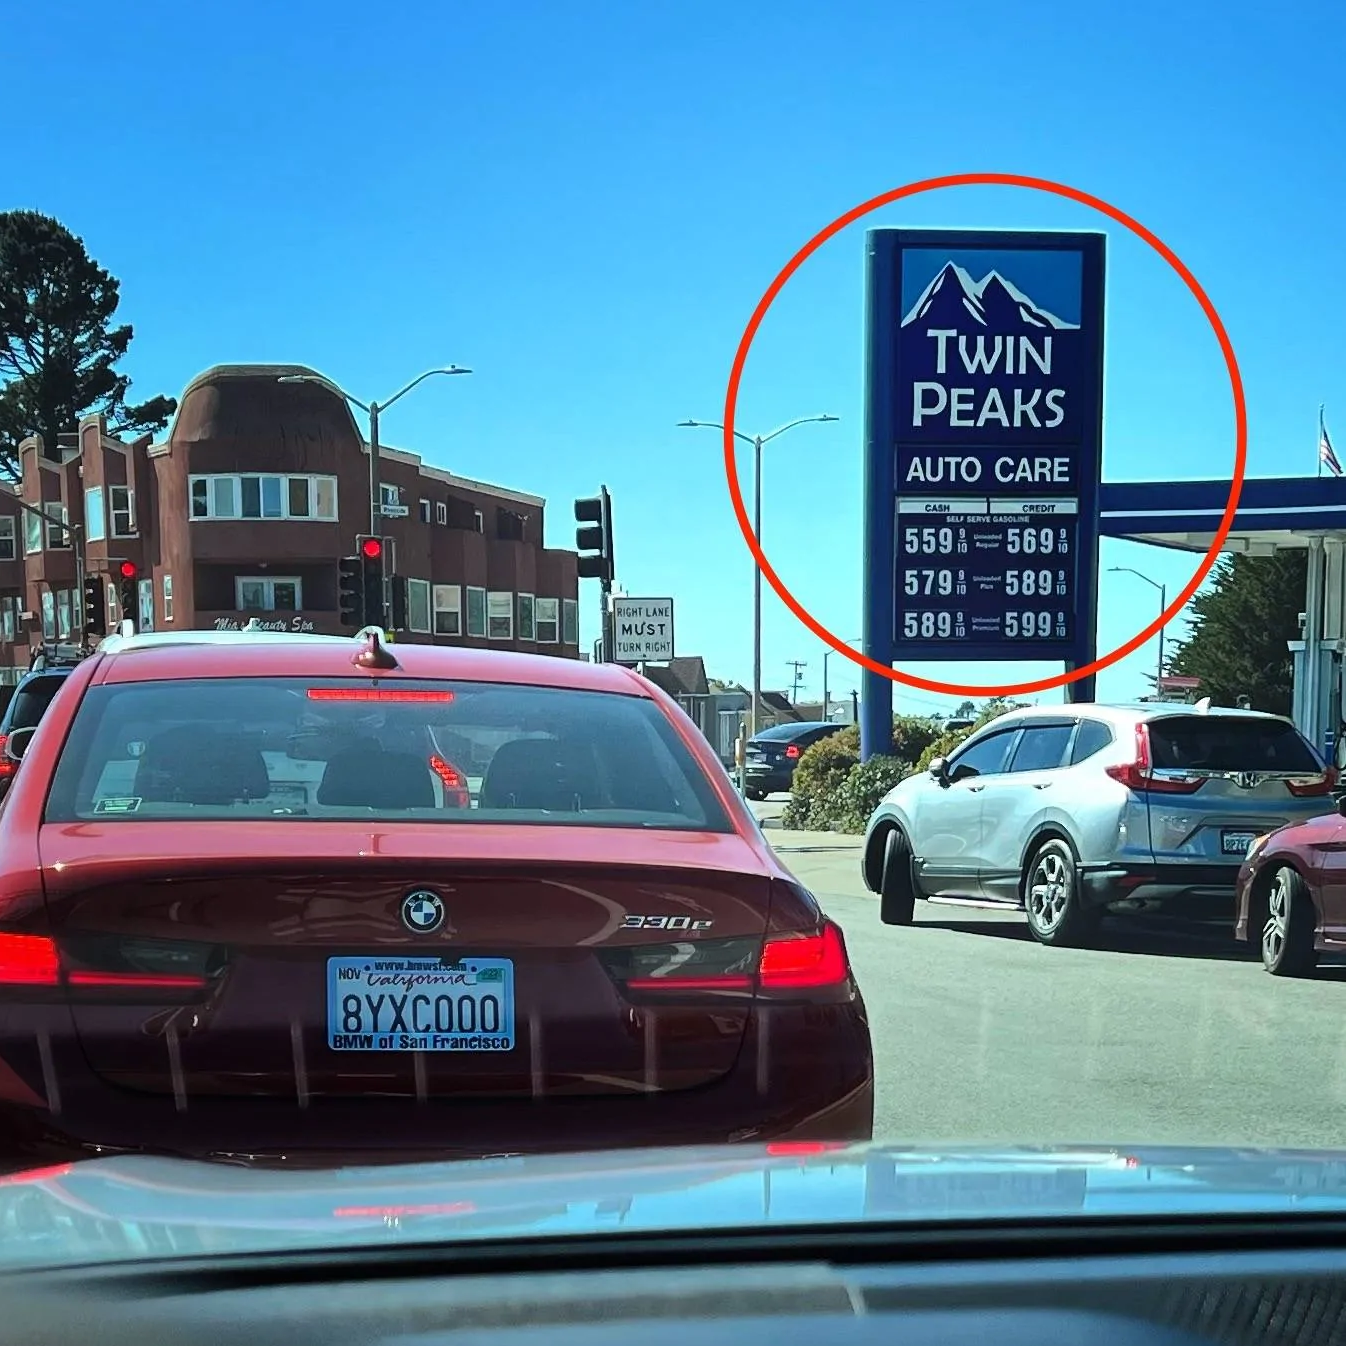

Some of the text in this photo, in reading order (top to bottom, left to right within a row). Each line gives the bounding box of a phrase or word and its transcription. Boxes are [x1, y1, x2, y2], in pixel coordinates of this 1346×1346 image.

[927, 329, 1053, 375] TWIN
[913, 382, 1066, 428] PEAKS
[906, 456, 1070, 483] AUTO CARE
[925, 504, 951, 513] CASH
[1022, 504, 1056, 513] CREDIT
[946, 515, 1030, 523] SELF SERVE GASOLINE
[905, 528, 953, 554] 559
[1007, 528, 1054, 554] 569
[904, 570, 952, 596] 579
[1005, 570, 1052, 596] 589
[617, 607, 670, 617] RIGHT LANE
[291, 616, 314, 632] Spa
[622, 623, 666, 636] MUST
[904, 612, 951, 638] 589
[1005, 612, 1052, 638] 599
[618, 642, 671, 652] TURN RIGHT
[620, 915, 713, 930] 330e
[338, 968, 361, 980] NOV
[367, 973, 477, 992] California
[342, 994, 499, 1033] 8YXC000
[333, 1034, 510, 1049] BMW of San Francisco
